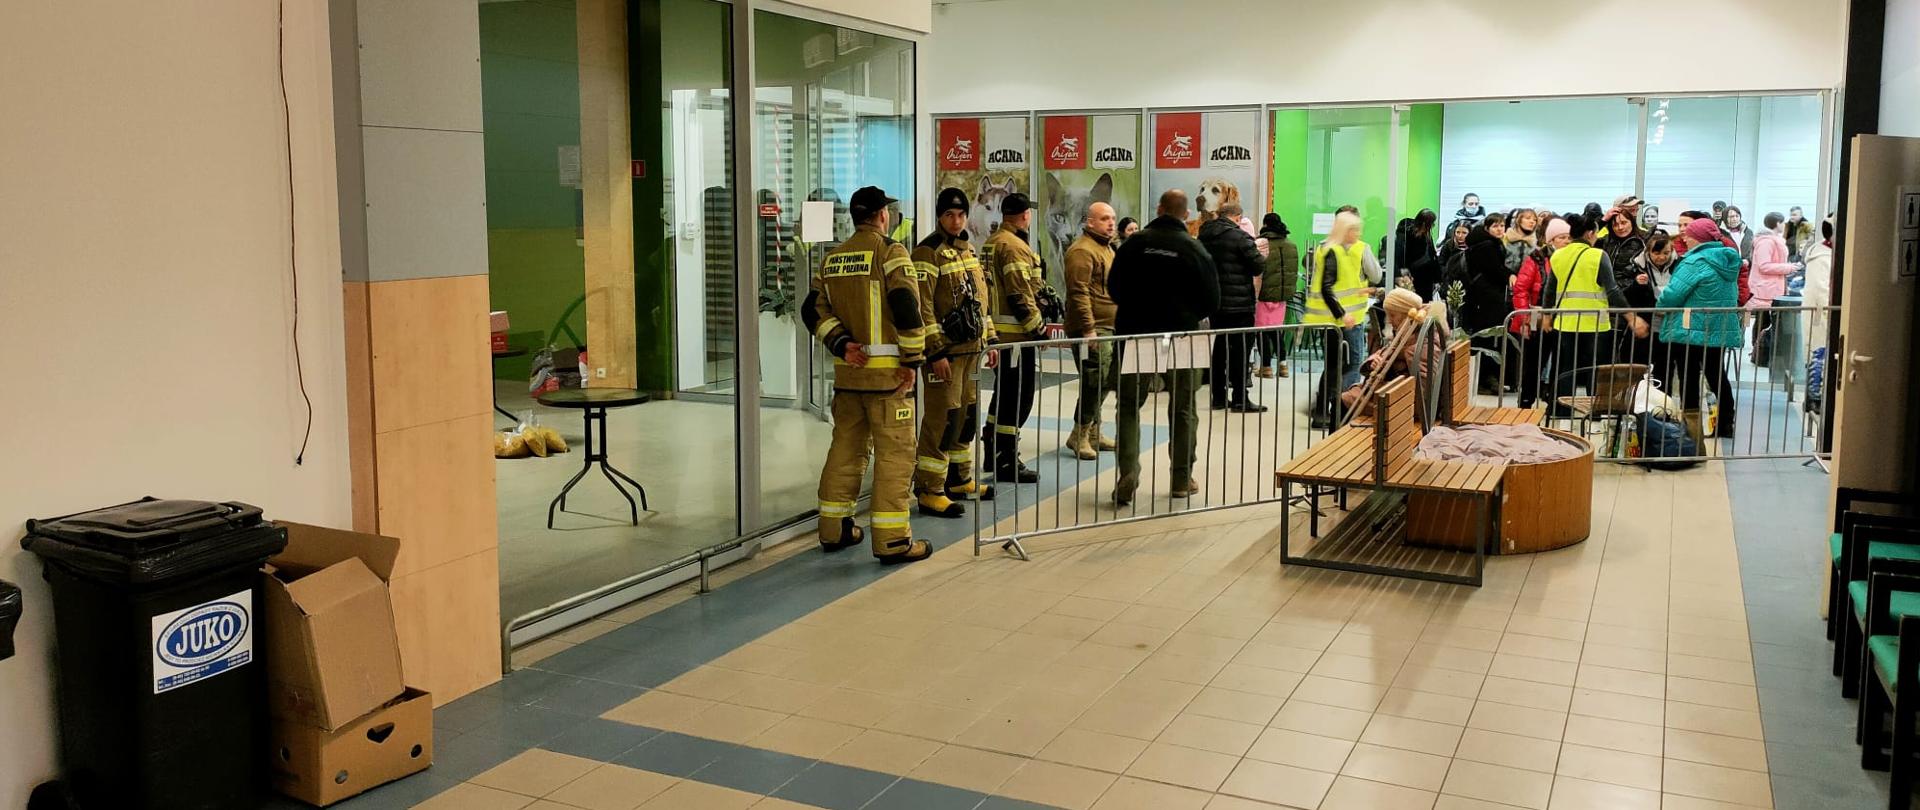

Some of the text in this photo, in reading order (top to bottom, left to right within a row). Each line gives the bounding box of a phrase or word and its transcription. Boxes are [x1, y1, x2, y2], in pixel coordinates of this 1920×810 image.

[987, 149, 1024, 163] ACANA
[1095, 147, 1133, 162] ACANA
[1210, 145, 1251, 160] ACANA
[175, 613, 234, 656] JUKO
